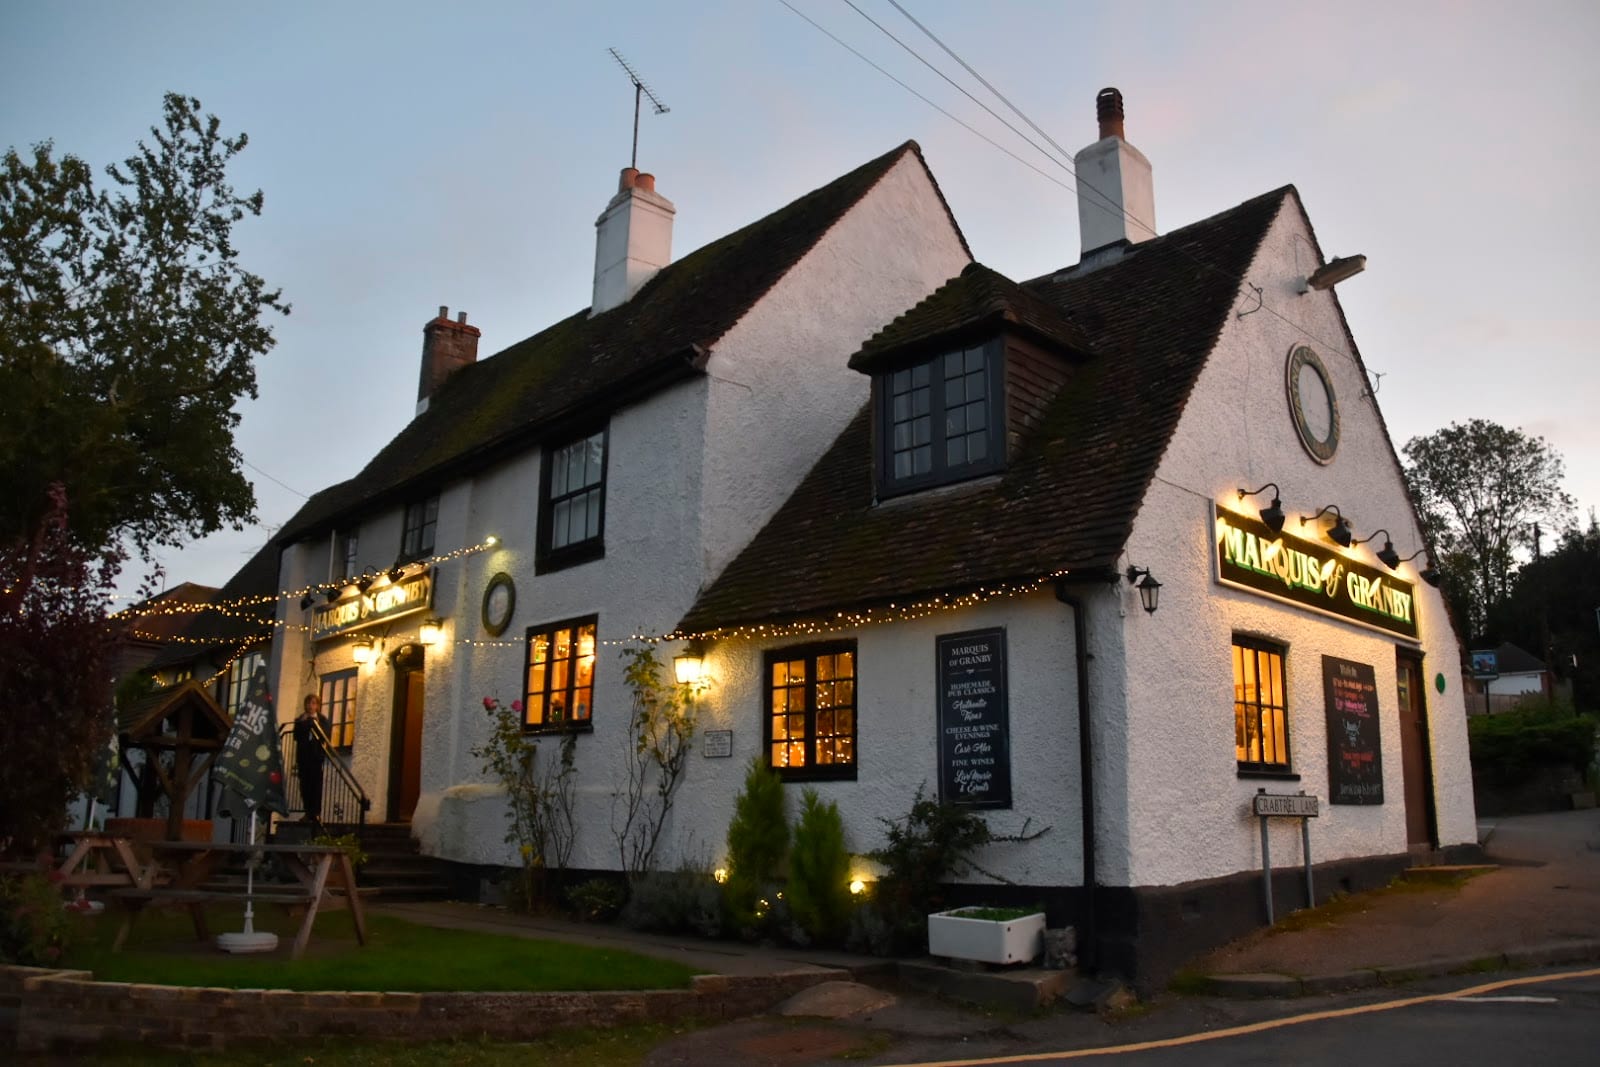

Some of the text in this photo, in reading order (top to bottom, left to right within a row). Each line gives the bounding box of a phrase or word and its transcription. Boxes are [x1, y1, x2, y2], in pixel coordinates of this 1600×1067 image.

[1224, 524, 1412, 624] MARQUIS of GRANBY
[952, 643, 989, 656] MARQUIS
[959, 654, 992, 666] GRANBY
[950, 680, 992, 690] HOMEMADE
[964, 686, 996, 696] CLASSICS
[945, 725, 971, 735] CHEESE
[980, 723, 1000, 731] WINE
[955, 732, 991, 741] EVENINGS
[952, 757, 995, 767] FINE WINES
[1300, 799, 1318, 814] LANE
